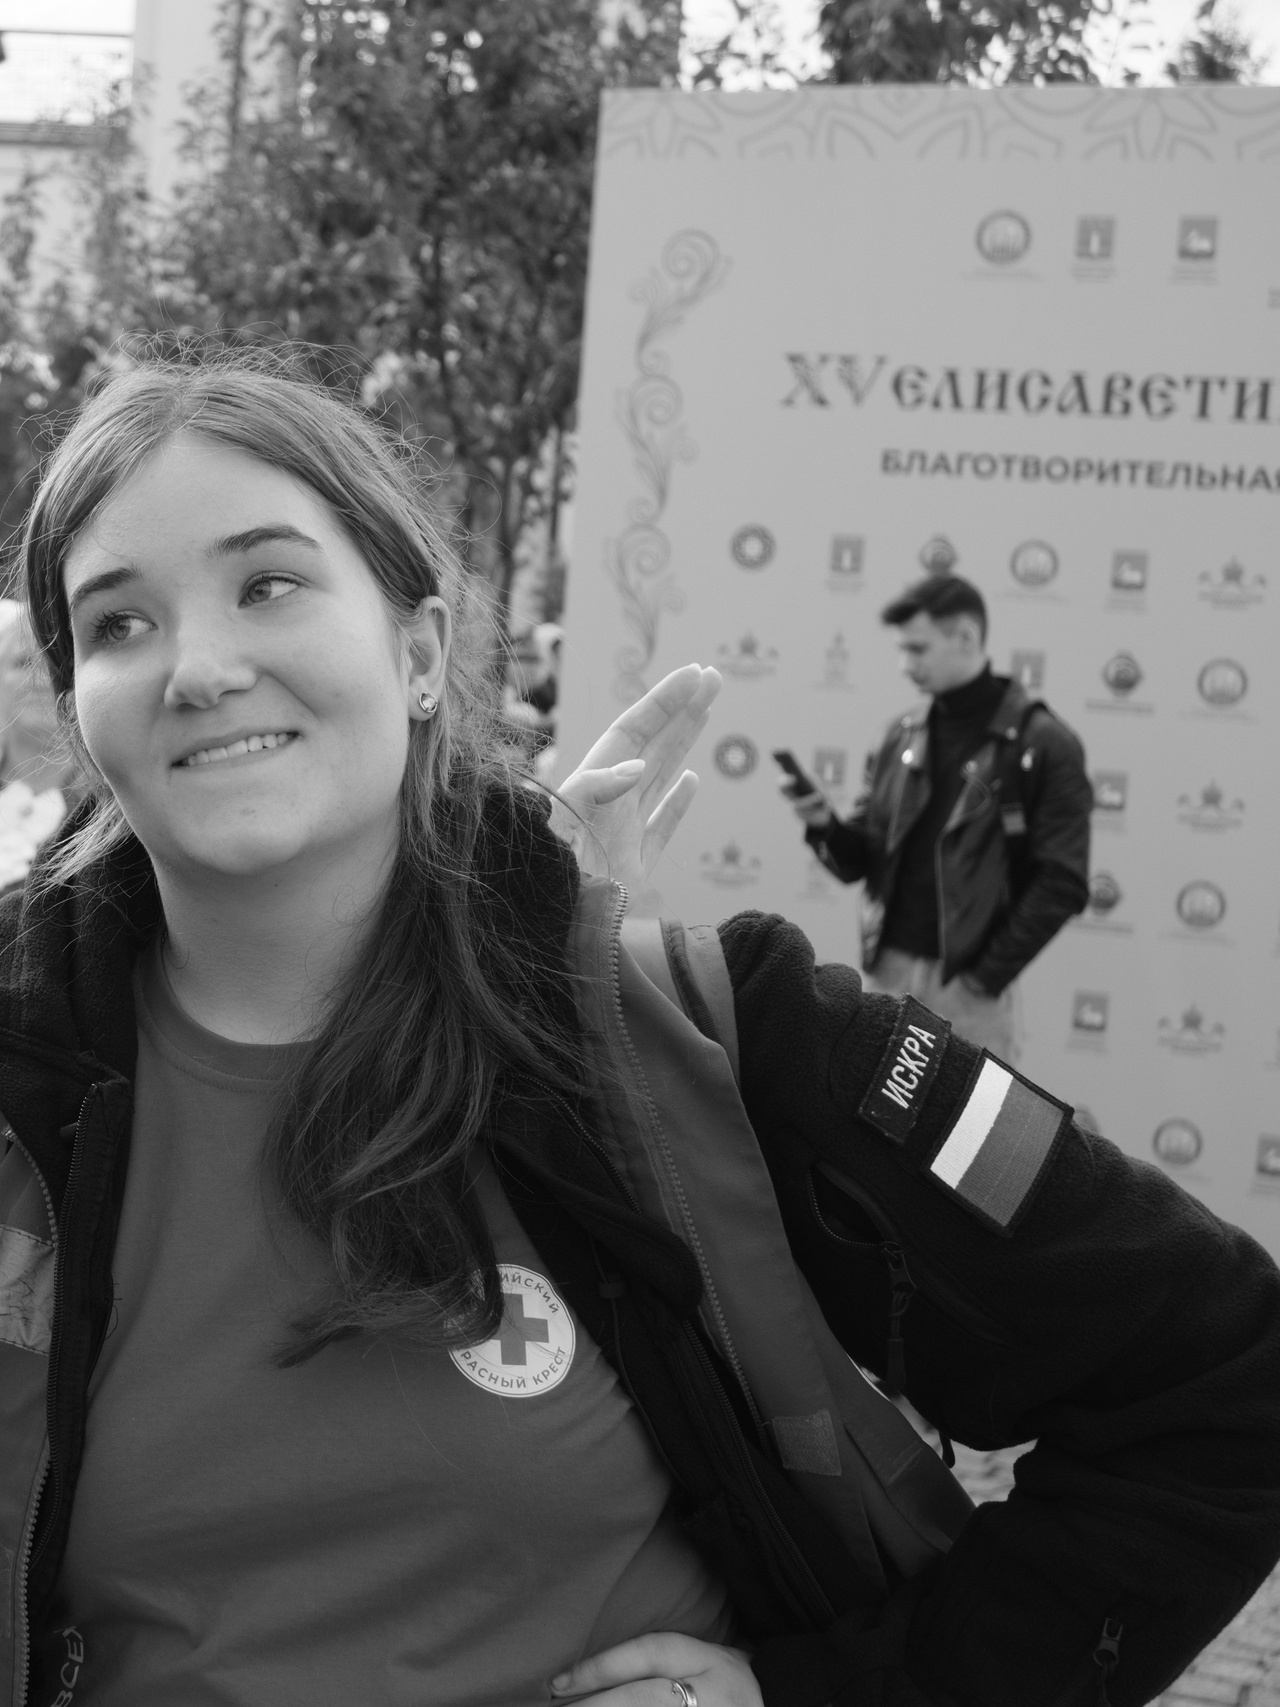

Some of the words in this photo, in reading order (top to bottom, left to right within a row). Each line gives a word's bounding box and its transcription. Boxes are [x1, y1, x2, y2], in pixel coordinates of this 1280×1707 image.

[784, 350, 887, 408] XV
[891, 364, 1280, 426] ЕЛИСАВЕТИ
[881, 1024, 936, 1109] ИСКРА
[456, 1349, 527, 1389] РАСНЫЙ
[532, 1346, 567, 1386] КРЕСТ
